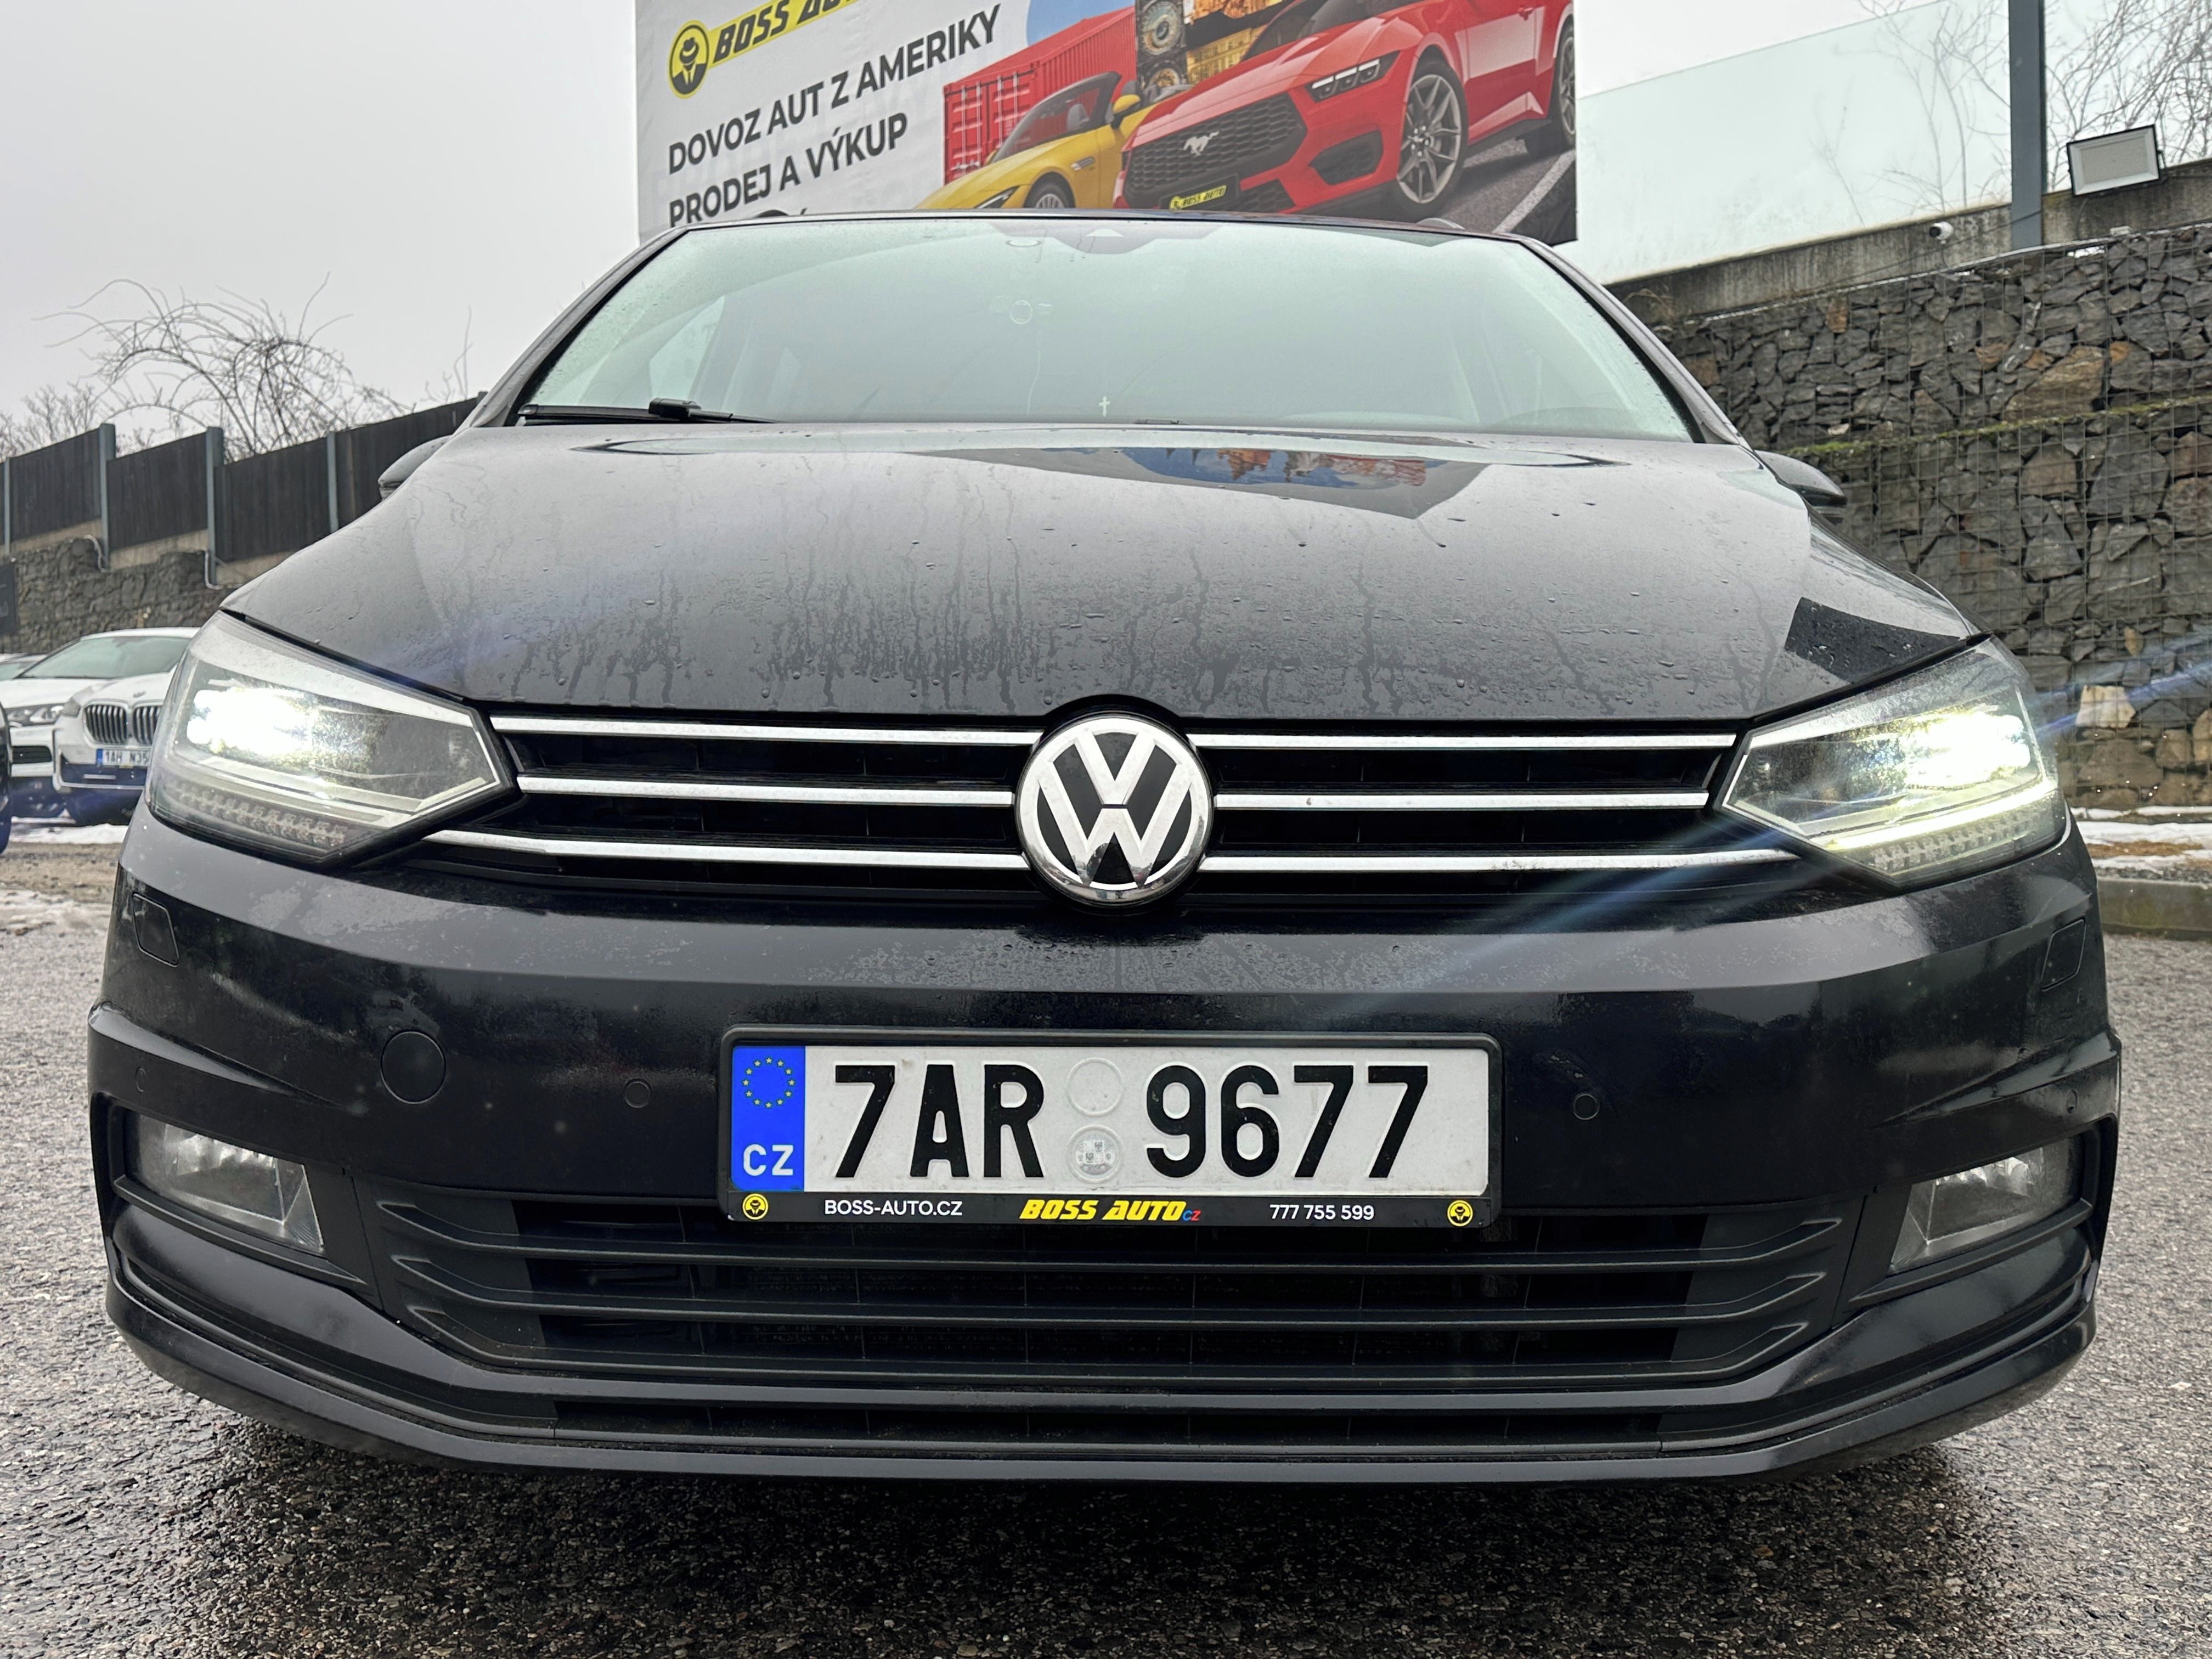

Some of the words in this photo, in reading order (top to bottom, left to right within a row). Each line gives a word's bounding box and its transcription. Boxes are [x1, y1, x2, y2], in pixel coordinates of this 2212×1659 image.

[713, 0, 789, 64] BOSS
[669, 109, 761, 174] DOVOZ
[767, 81, 824, 136] AUT
[831, 70, 849, 109] Z
[856, 3, 1001, 99] AMERIKY
[669, 164, 771, 228] PRODEJ
[780, 155, 801, 192] A
[805, 112, 907, 178] VÝKUP
[742, 1144, 794, 1177] CZ
[834, 1064, 1045, 1178] 7AR
[1146, 1064, 1429, 1178] 9677
[824, 1199, 963, 1216] BOSS-AUTO.CZ
[1018, 1199, 1099, 1220] BOSS
[1101, 1200, 1187, 1221] AUTO
[1269, 1204, 1300, 1220] 777
[1304, 1204, 1336, 1220] 755
[1340, 1205, 1375, 1221] 599
